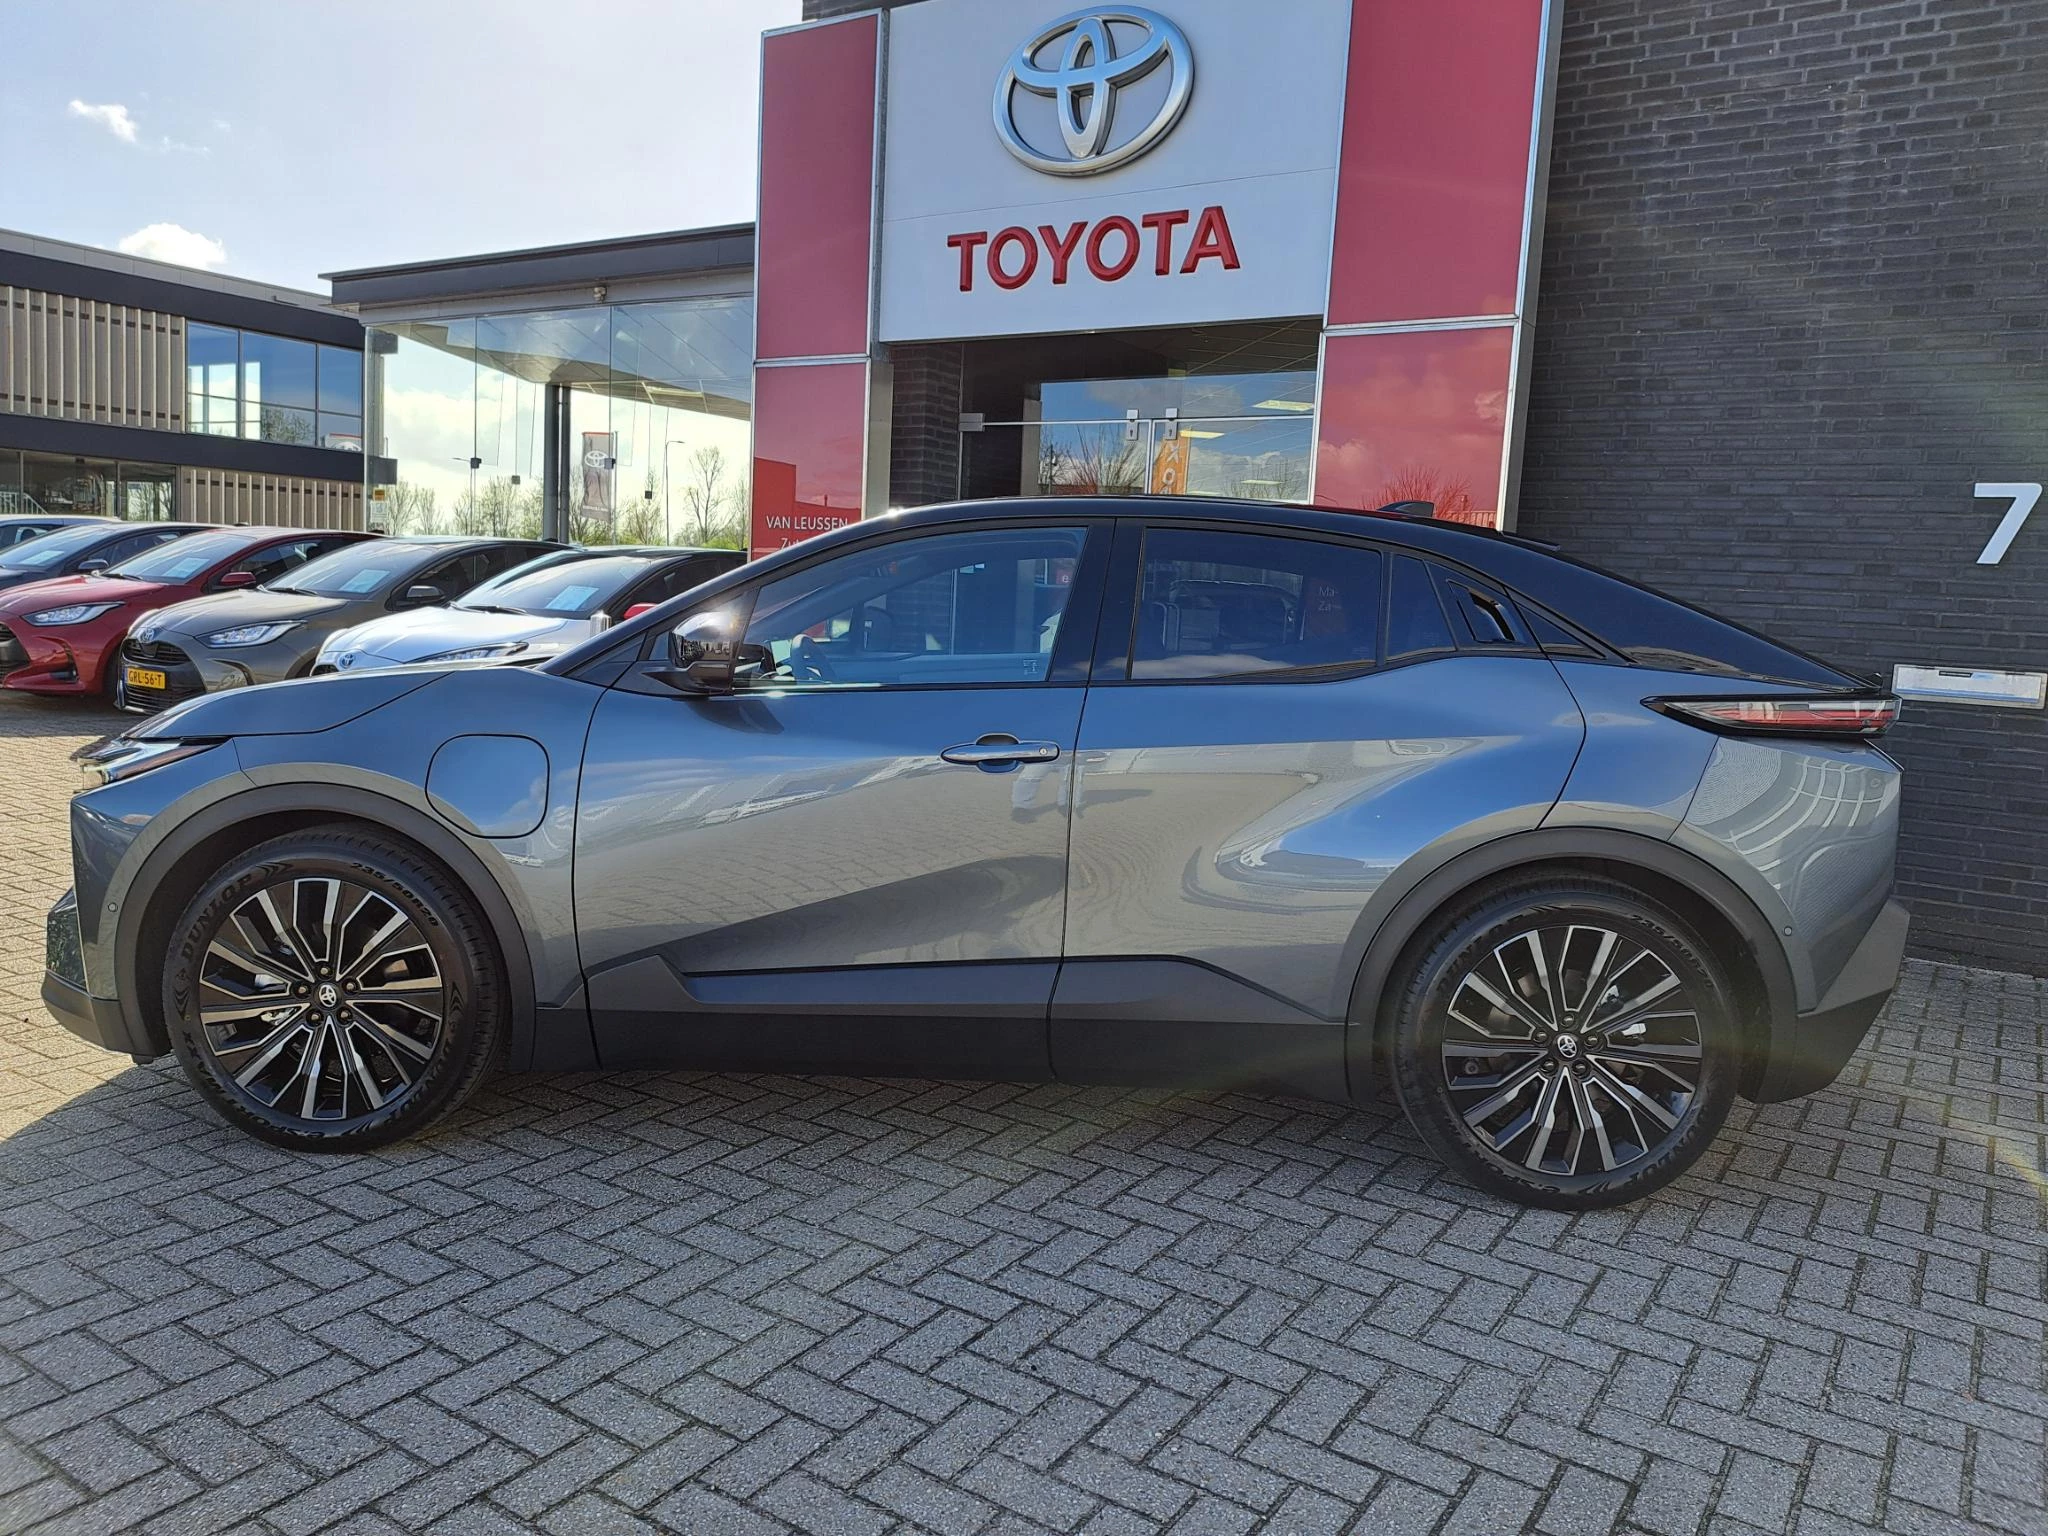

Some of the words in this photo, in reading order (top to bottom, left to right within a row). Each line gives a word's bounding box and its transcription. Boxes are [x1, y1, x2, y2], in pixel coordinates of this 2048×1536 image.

[947, 206, 1240, 292] TOYOTA
[766, 515, 791, 529] VAN
[794, 516, 848, 530] LEUSSEN
[1974, 483, 2043, 564] 7
[128, 670, 162, 686] GRL-56-T
[181, 873, 252, 960] DUNLOP
[350, 862, 439, 927] 235/50R20
